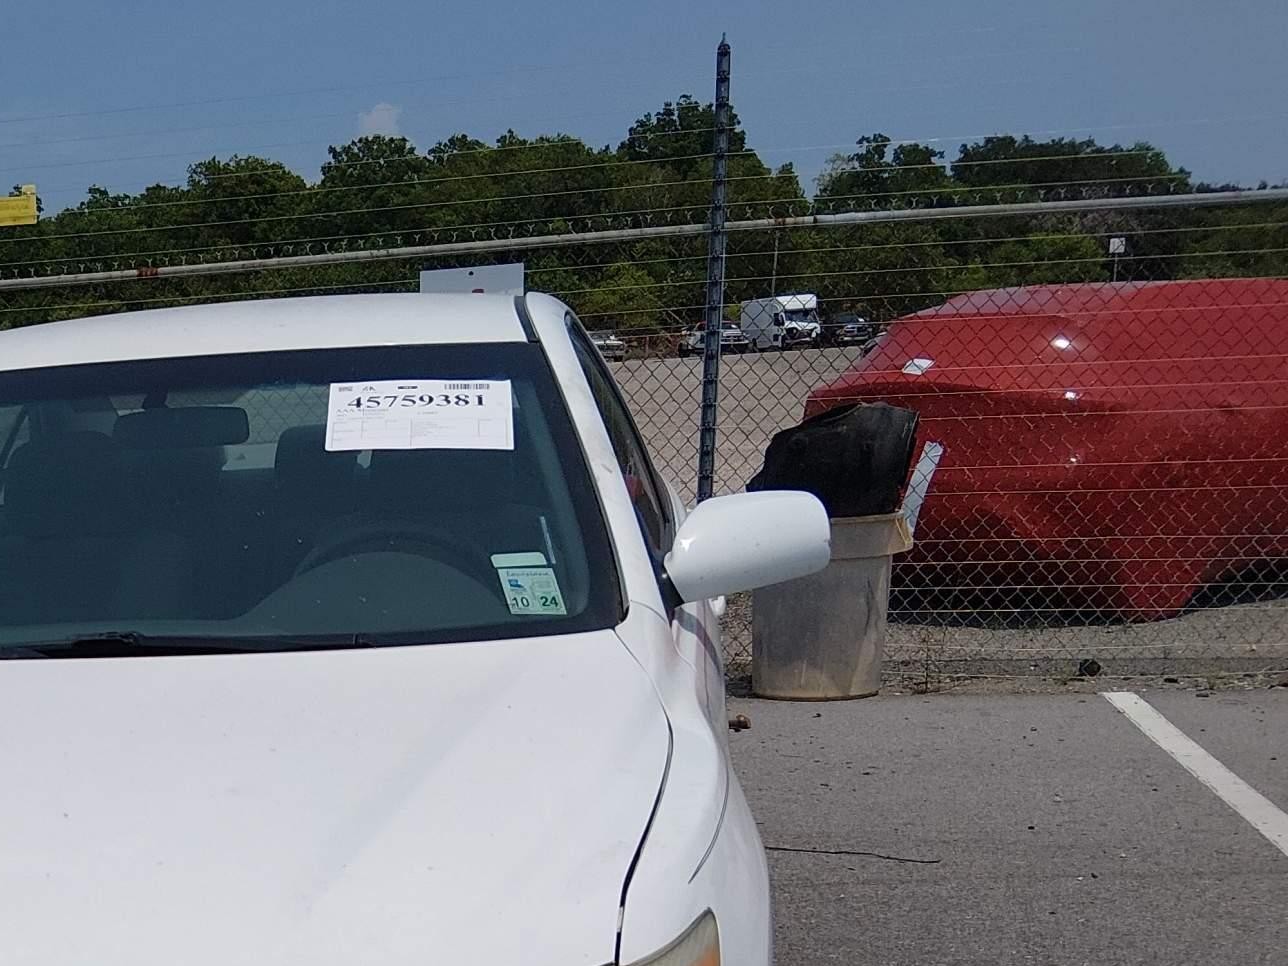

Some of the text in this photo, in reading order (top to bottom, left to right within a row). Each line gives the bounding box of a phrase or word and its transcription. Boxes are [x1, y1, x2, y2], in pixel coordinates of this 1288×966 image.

[347, 394, 485, 409] 45759381
[511, 595, 559, 608] 10 24
